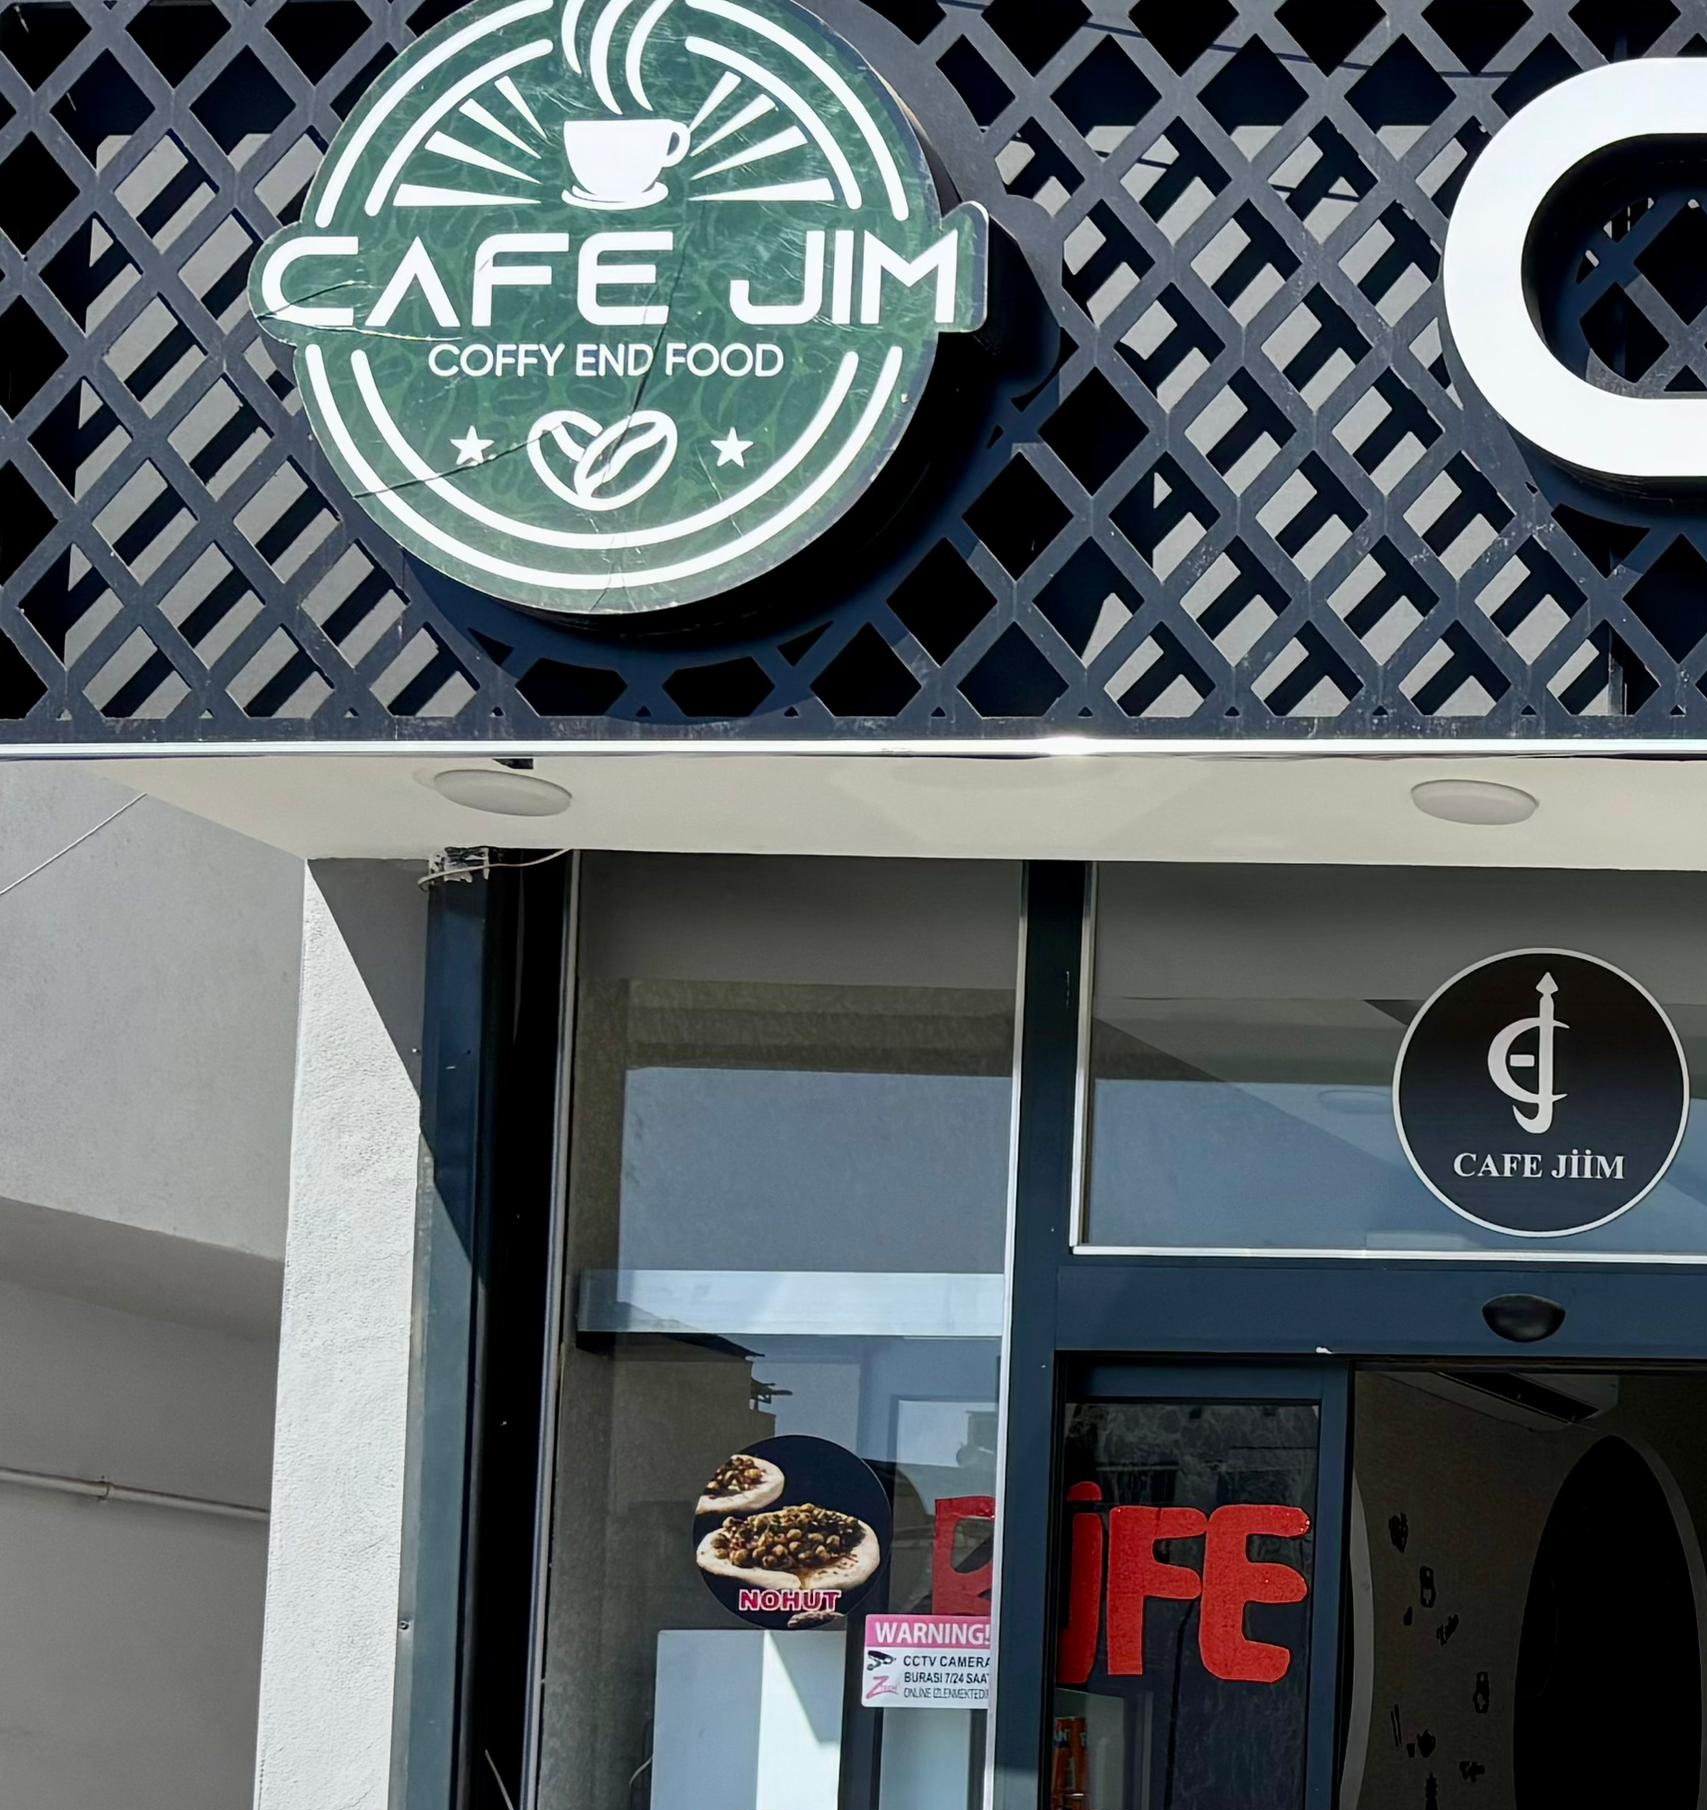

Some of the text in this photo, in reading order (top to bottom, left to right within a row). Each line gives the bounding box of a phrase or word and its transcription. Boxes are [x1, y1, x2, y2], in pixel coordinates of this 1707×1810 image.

[261, 229, 960, 328] CAFE JIM
[428, 343, 785, 378] COFFY END FOOD
[1453, 1152, 1542, 1178] CAFE
[738, 1588, 842, 1612] NOHUT
[875, 1621, 990, 1645] WARNING!
[903, 1655, 937, 1667] CCTV
[904, 1671, 990, 1684] BURASI 7/24 SAA
